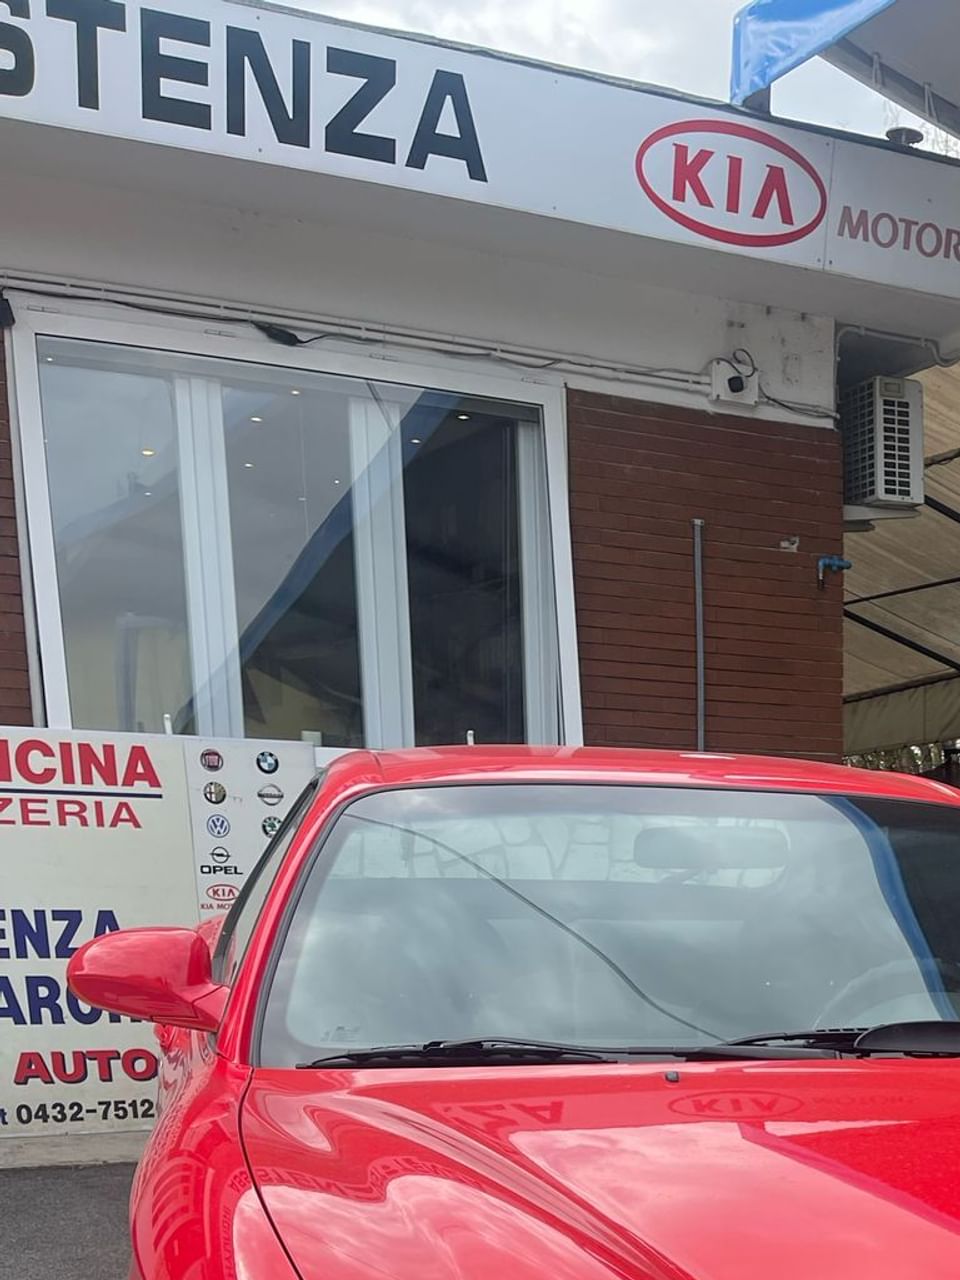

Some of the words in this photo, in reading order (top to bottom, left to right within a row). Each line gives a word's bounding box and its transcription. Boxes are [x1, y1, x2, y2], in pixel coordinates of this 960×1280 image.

[671, 142, 794, 226] KIA
[200, 865, 243, 875] OPEL
[212, 887, 236, 897] KIA
[14, 1048, 158, 1085] AUTO
[16, 1098, 155, 1125] 0432-7512
